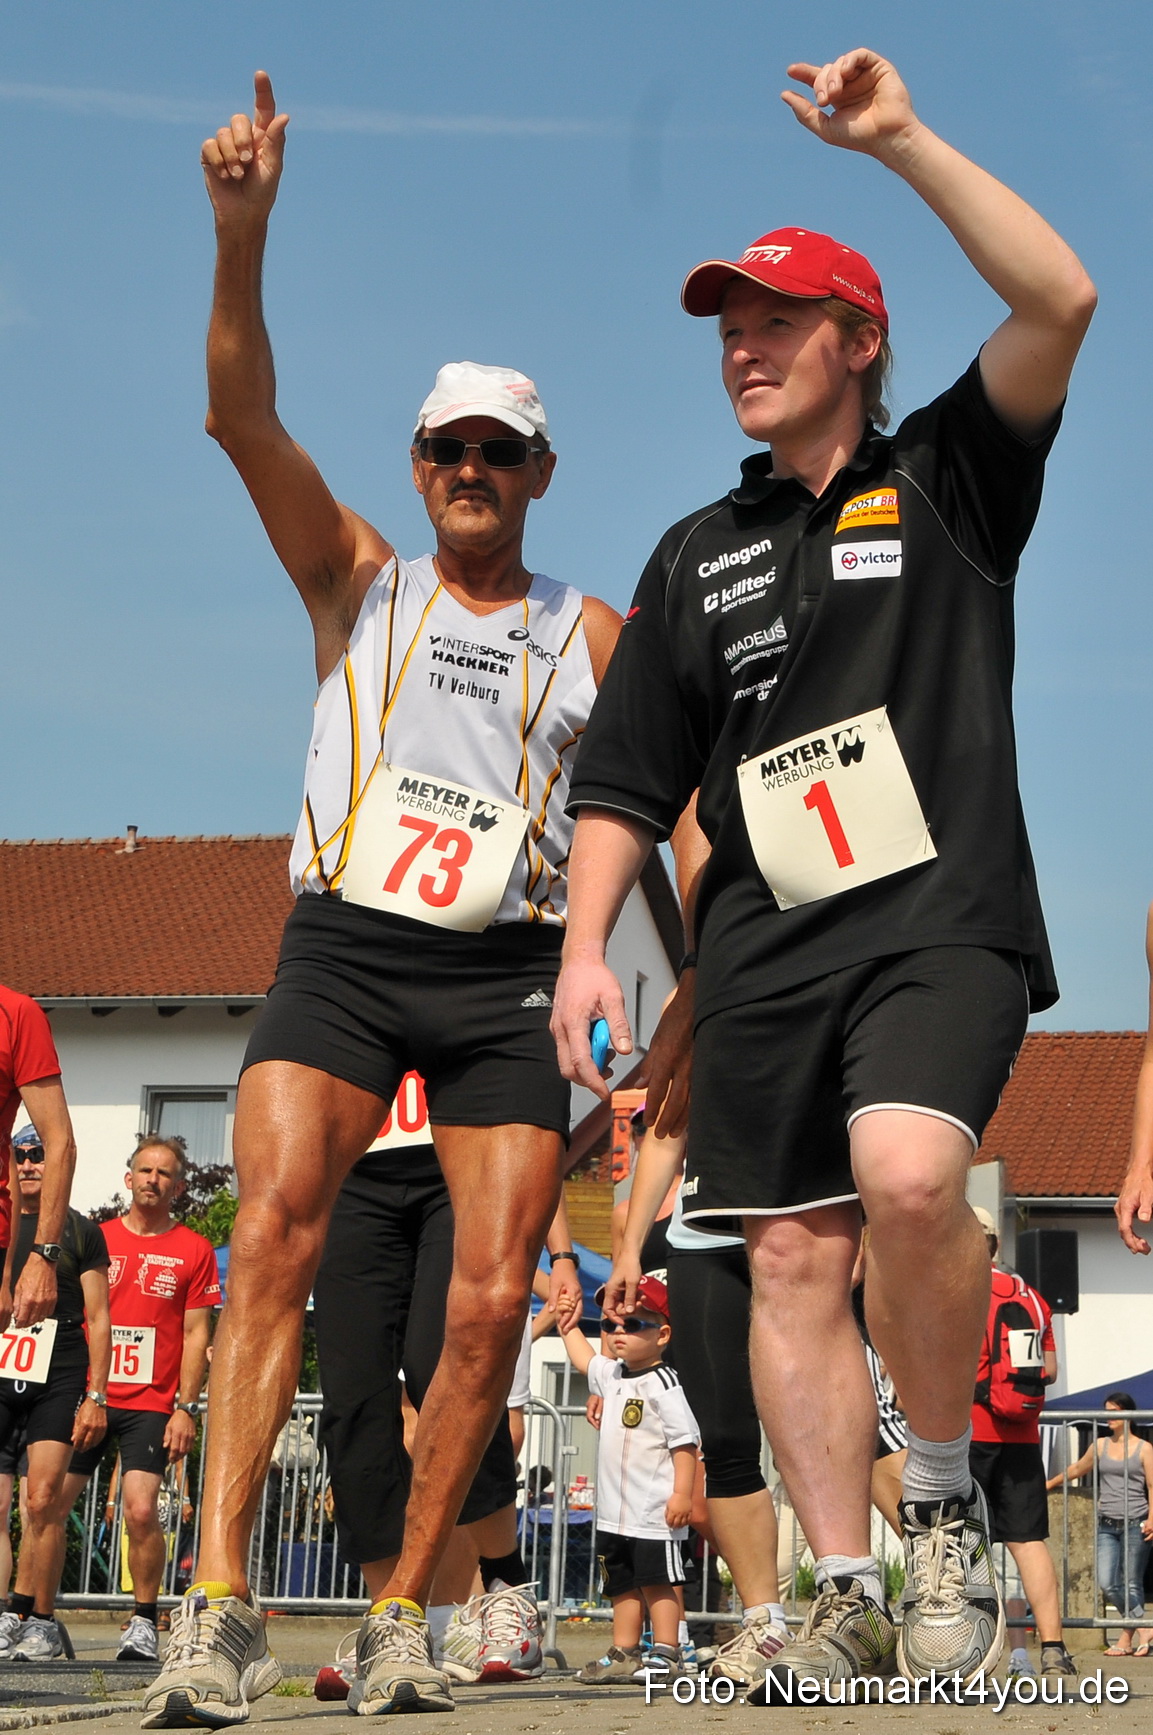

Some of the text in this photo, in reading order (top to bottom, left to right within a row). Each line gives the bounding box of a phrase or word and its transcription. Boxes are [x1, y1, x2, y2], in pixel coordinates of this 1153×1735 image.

[698, 539, 772, 578] Cellagon
[721, 571, 776, 605] killtec
[721, 589, 768, 613] sportswear
[443, 637, 516, 664] INTERSPORT
[526, 639, 557, 667] asics
[724, 624, 787, 665] AMADEUS
[431, 649, 510, 676] HACKNER
[429, 672, 500, 704] TV Velburg
[761, 738, 830, 780] MEYER
[762, 757, 835, 792] WERBUNG
[396, 792, 466, 821] WERBUNG
[398, 777, 470, 810] MEYER
[803, 780, 855, 869] 1
[382, 814, 473, 908] 73
[0, 1333, 37, 1372] 70
